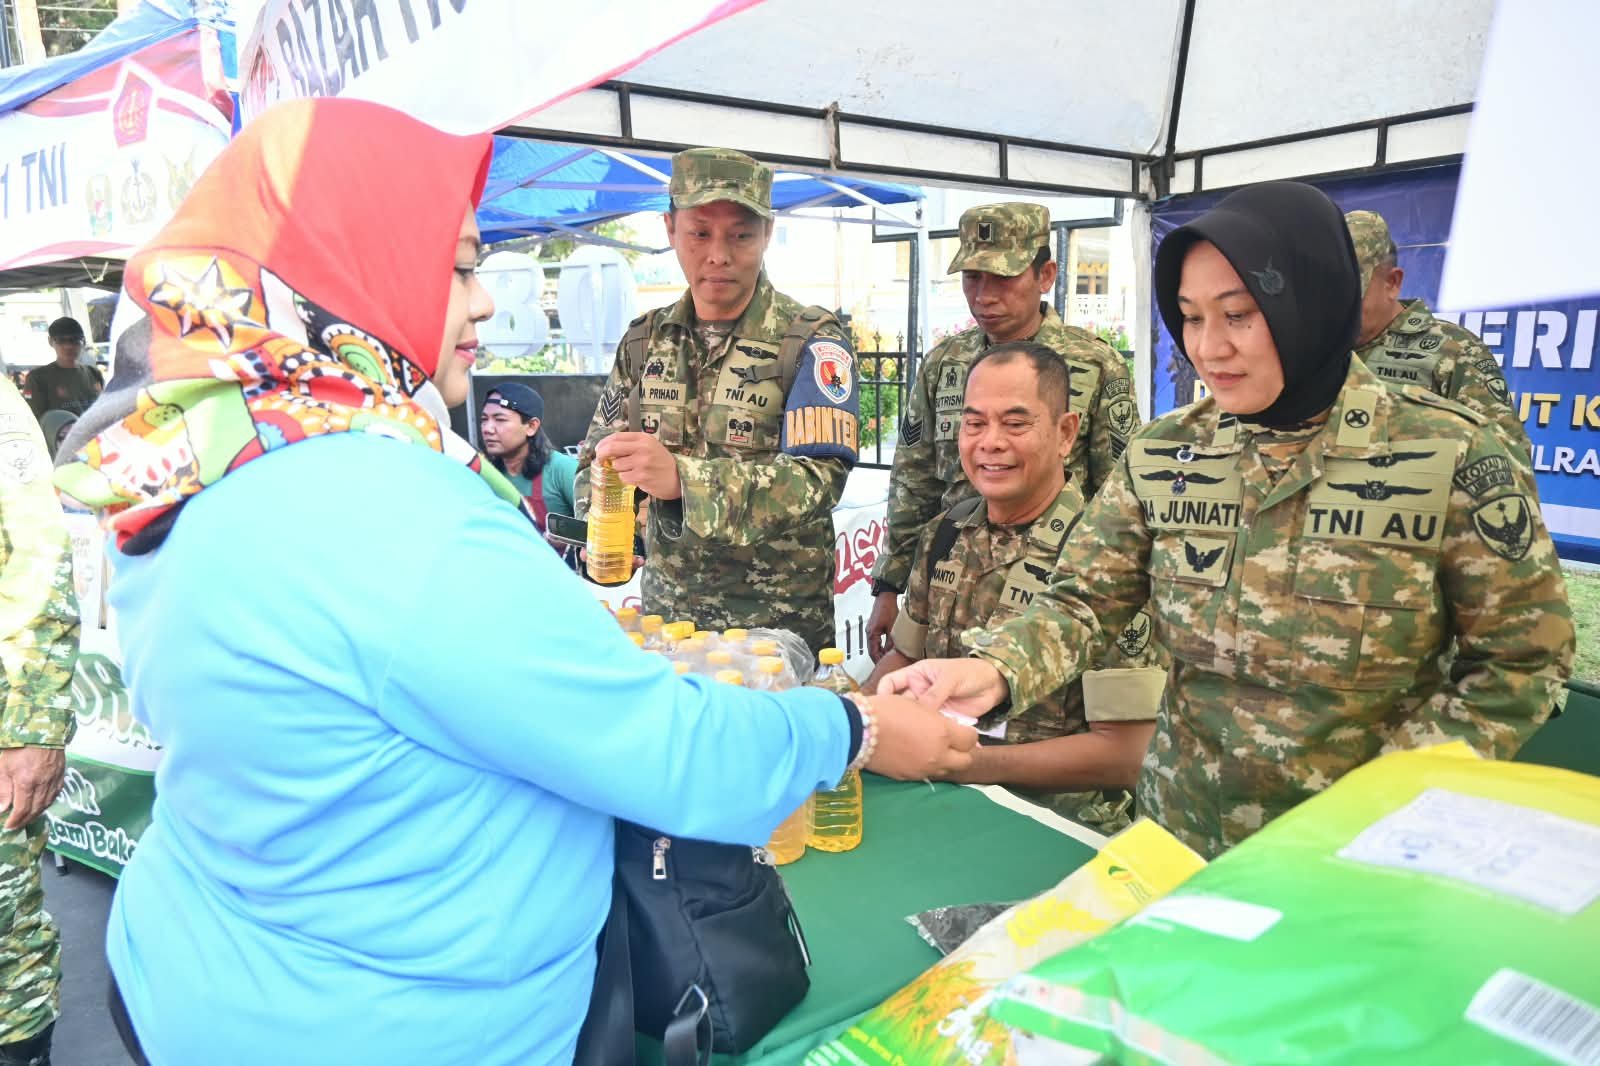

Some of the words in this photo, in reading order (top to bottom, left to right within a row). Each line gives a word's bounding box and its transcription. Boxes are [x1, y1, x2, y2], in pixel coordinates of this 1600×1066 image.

[21, 141, 68, 214] TNI
[1432, 310, 1598, 369] ERI
[1376, 366, 1398, 378] TNI
[1400, 370, 1418, 381] AU
[649, 387, 679, 400] PRIHADI
[725, 388, 745, 401] TNI
[747, 393, 768, 407] AU
[786, 406, 858, 449] BABINTE
[1531, 444, 1600, 475] LRA
[1160, 500, 1240, 527] JUNIATI
[1309, 508, 1364, 536] TNI
[1381, 513, 1437, 541] AU
[1010, 586, 1034, 606] TN
